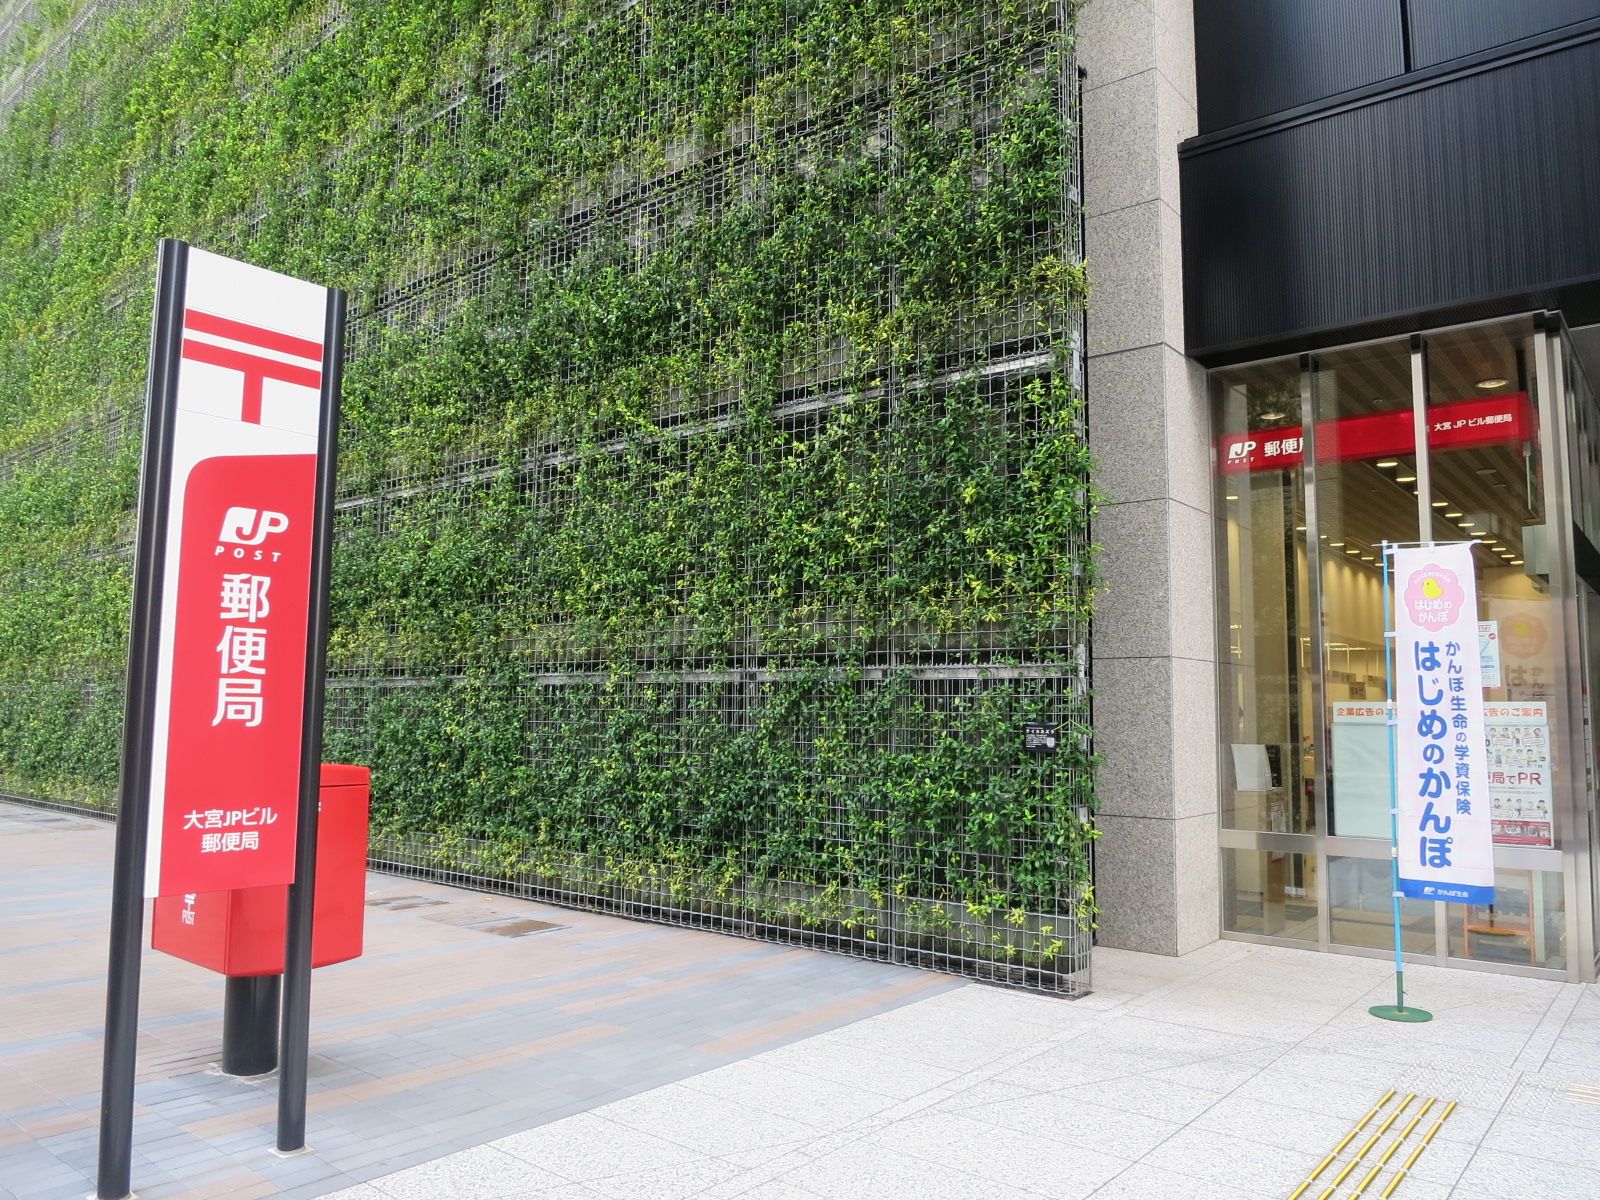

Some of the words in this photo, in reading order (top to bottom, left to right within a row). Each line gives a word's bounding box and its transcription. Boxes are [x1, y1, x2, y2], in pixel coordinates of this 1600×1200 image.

[1434, 421, 1451, 432] 大宮
[1453, 420, 1466, 429] JP
[1468, 413, 1512, 427] ビル郵便局
[1229, 441, 1256, 459] JP
[1228, 457, 1255, 465] POST
[219, 506, 289, 545] JP
[214, 545, 282, 562] POST
[1414, 599, 1451, 610] はじめの
[212, 573, 271, 727] 郵便局
[1445, 641, 1472, 815] かんぽ生命の学資保険
[1414, 640, 1454, 868] はじめのかんぽ
[1488, 772, 1542, 786] 局でPR
[183, 807, 278, 830] 大宮JPビル
[201, 831, 259, 853] 郵便局
[182, 909, 196, 926] POST
